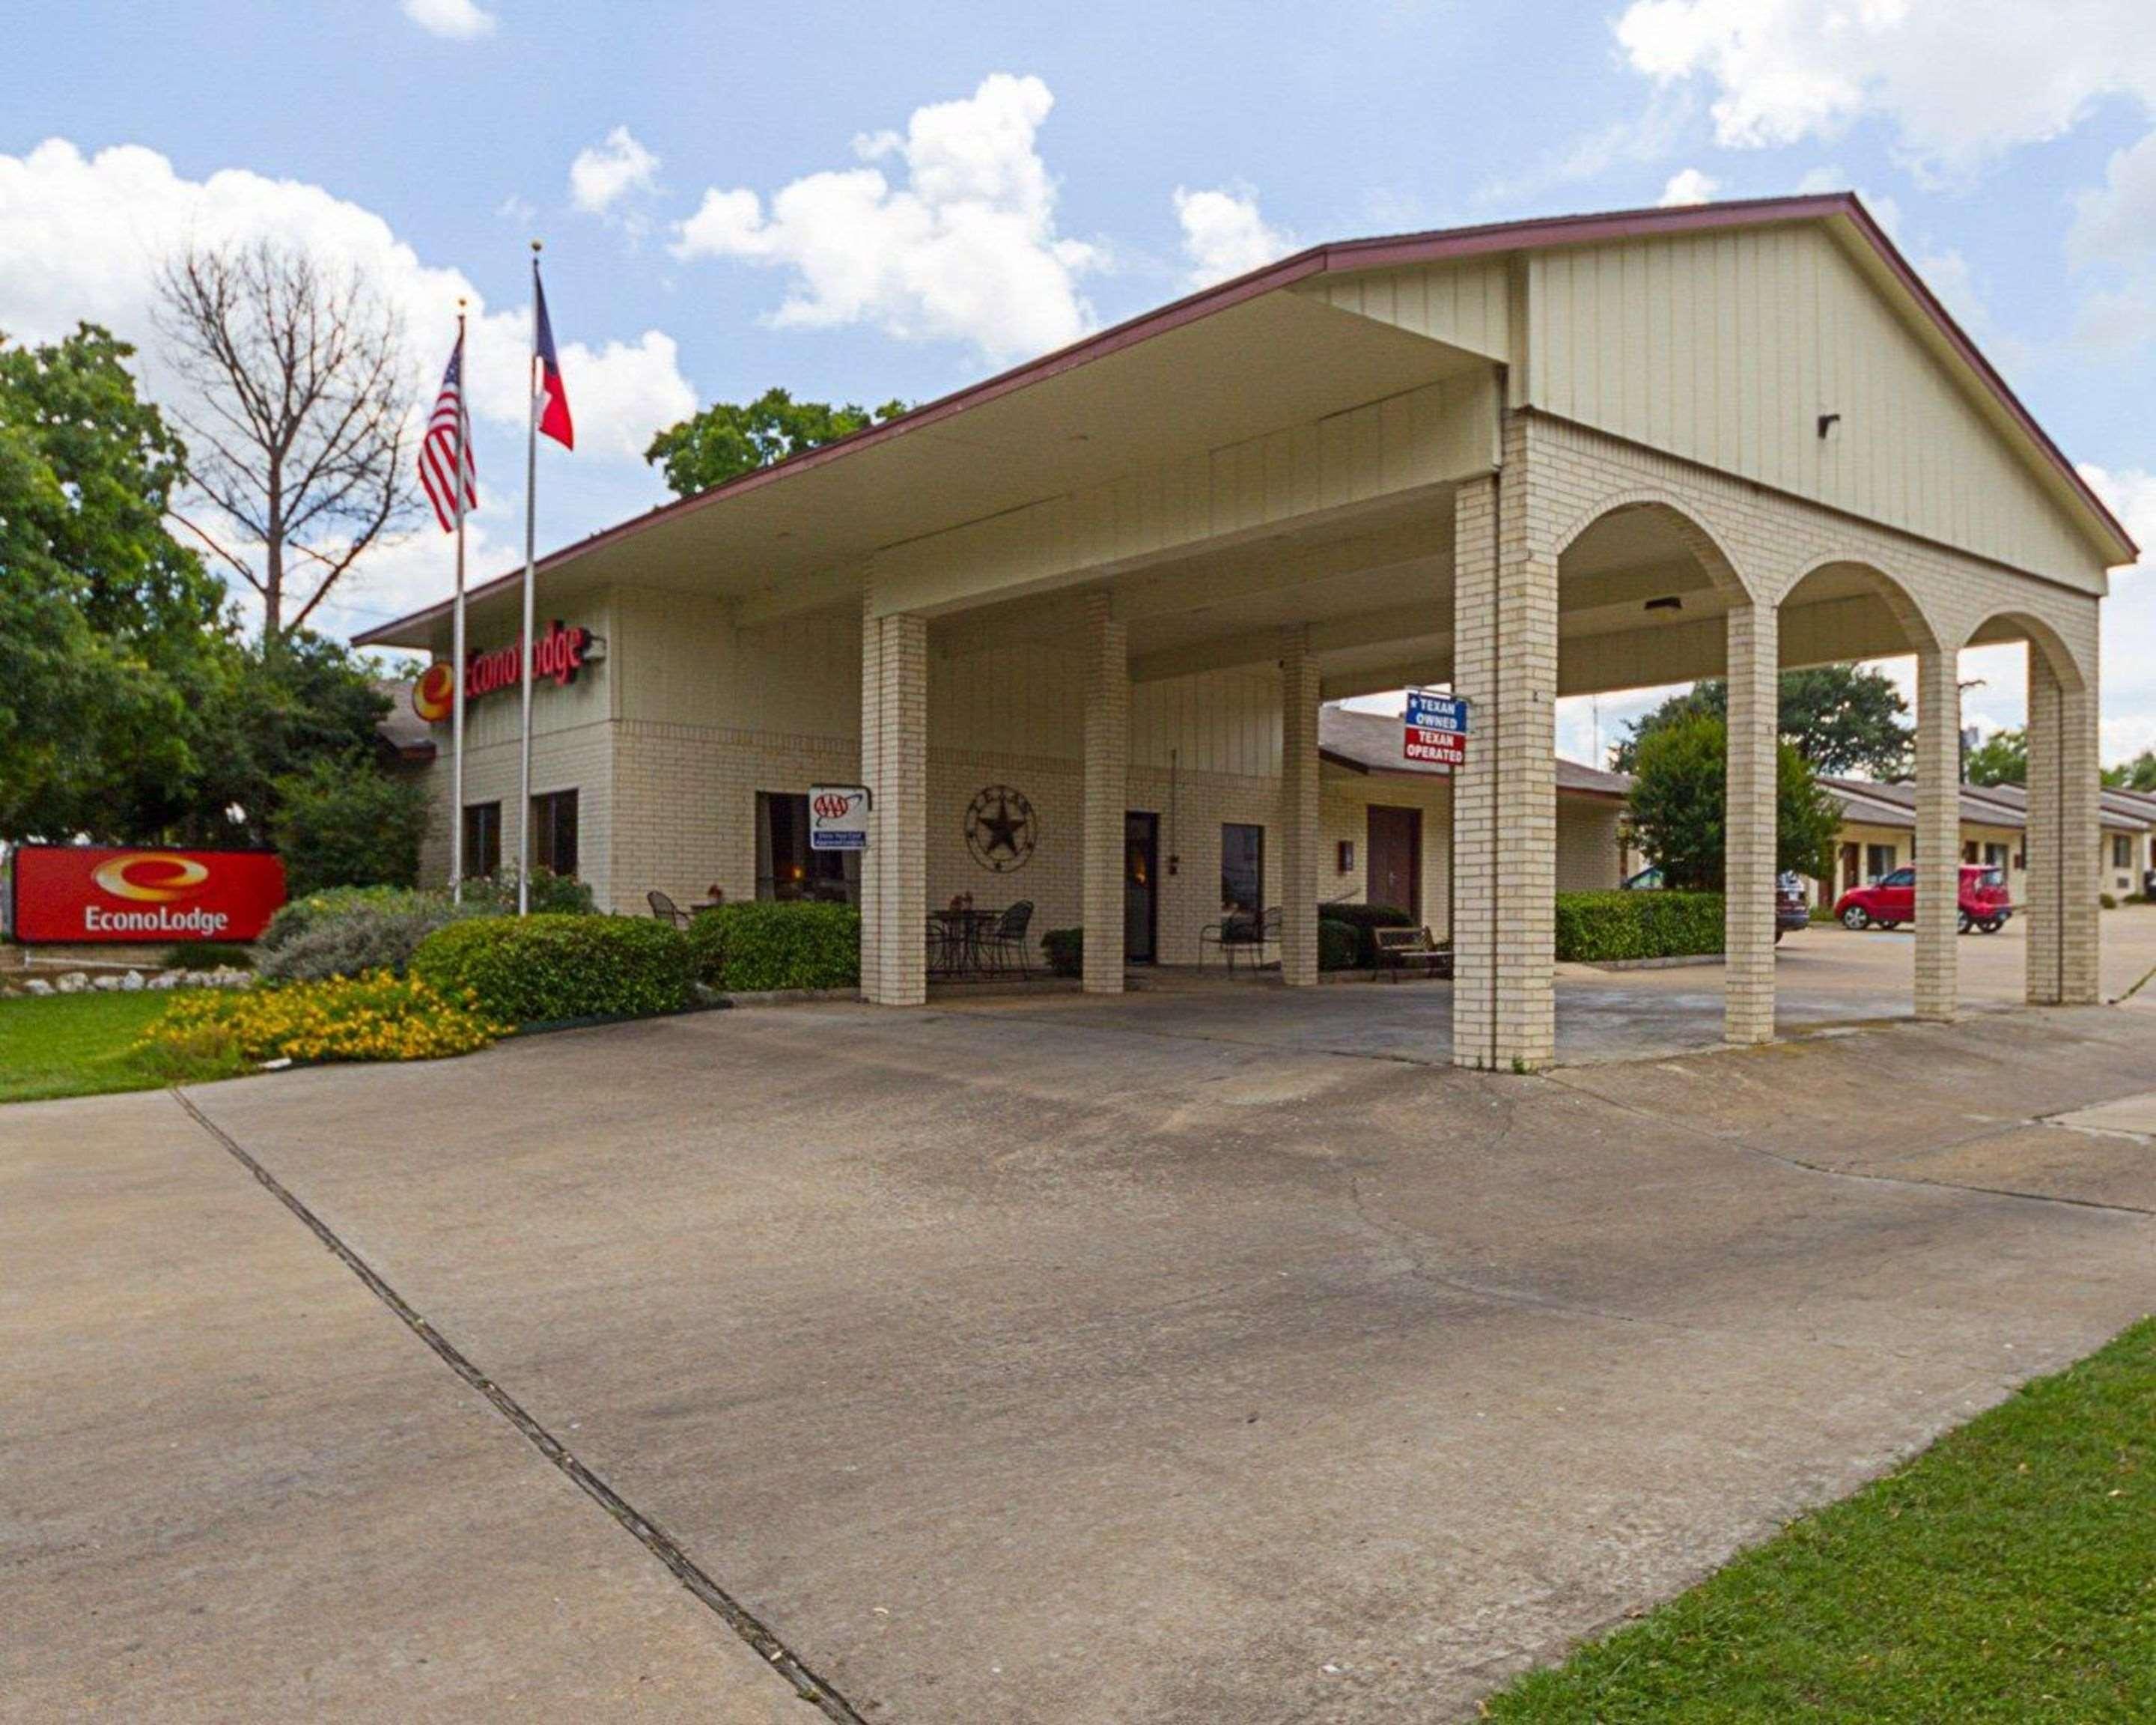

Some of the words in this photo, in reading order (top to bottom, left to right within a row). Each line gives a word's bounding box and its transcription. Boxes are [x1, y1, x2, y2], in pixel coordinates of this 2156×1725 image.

[1421, 698, 1456, 714] TEXAN
[1416, 712, 1458, 730] OWNED
[1418, 730, 1454, 747] TEXAN
[1406, 743, 1463, 762] OPERATED
[814, 794, 848, 818] AAA
[85, 906, 228, 935] EconoLodge
